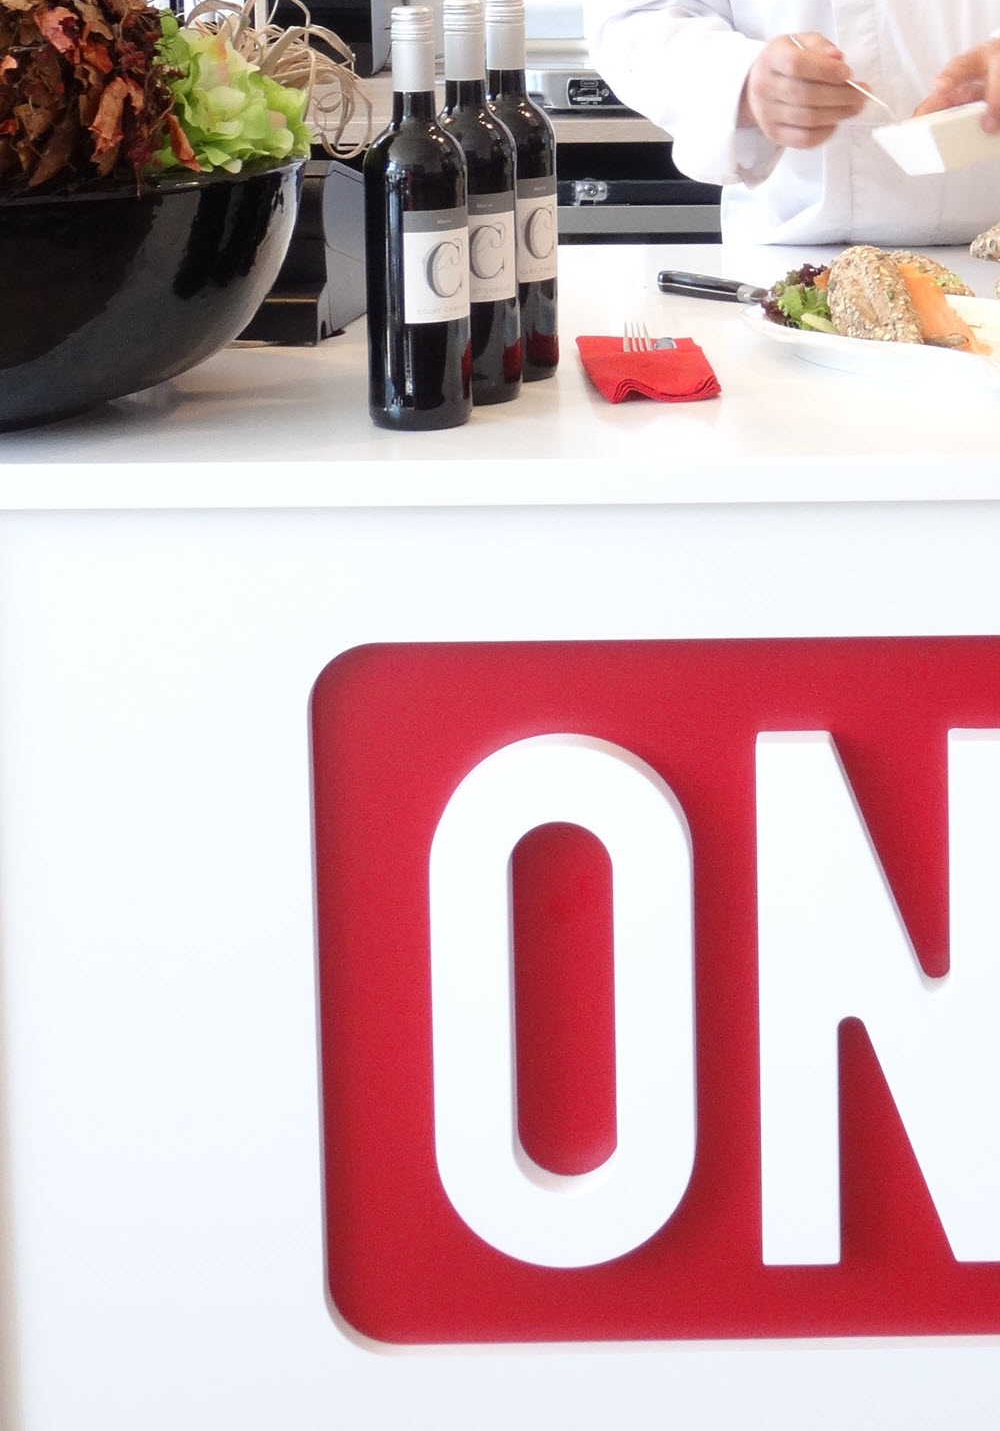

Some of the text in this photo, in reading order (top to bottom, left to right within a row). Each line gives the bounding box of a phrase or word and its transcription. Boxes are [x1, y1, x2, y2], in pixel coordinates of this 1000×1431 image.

[468, 224, 505, 280] C
[524, 206, 555, 260] C
[426, 240, 463, 299] C
